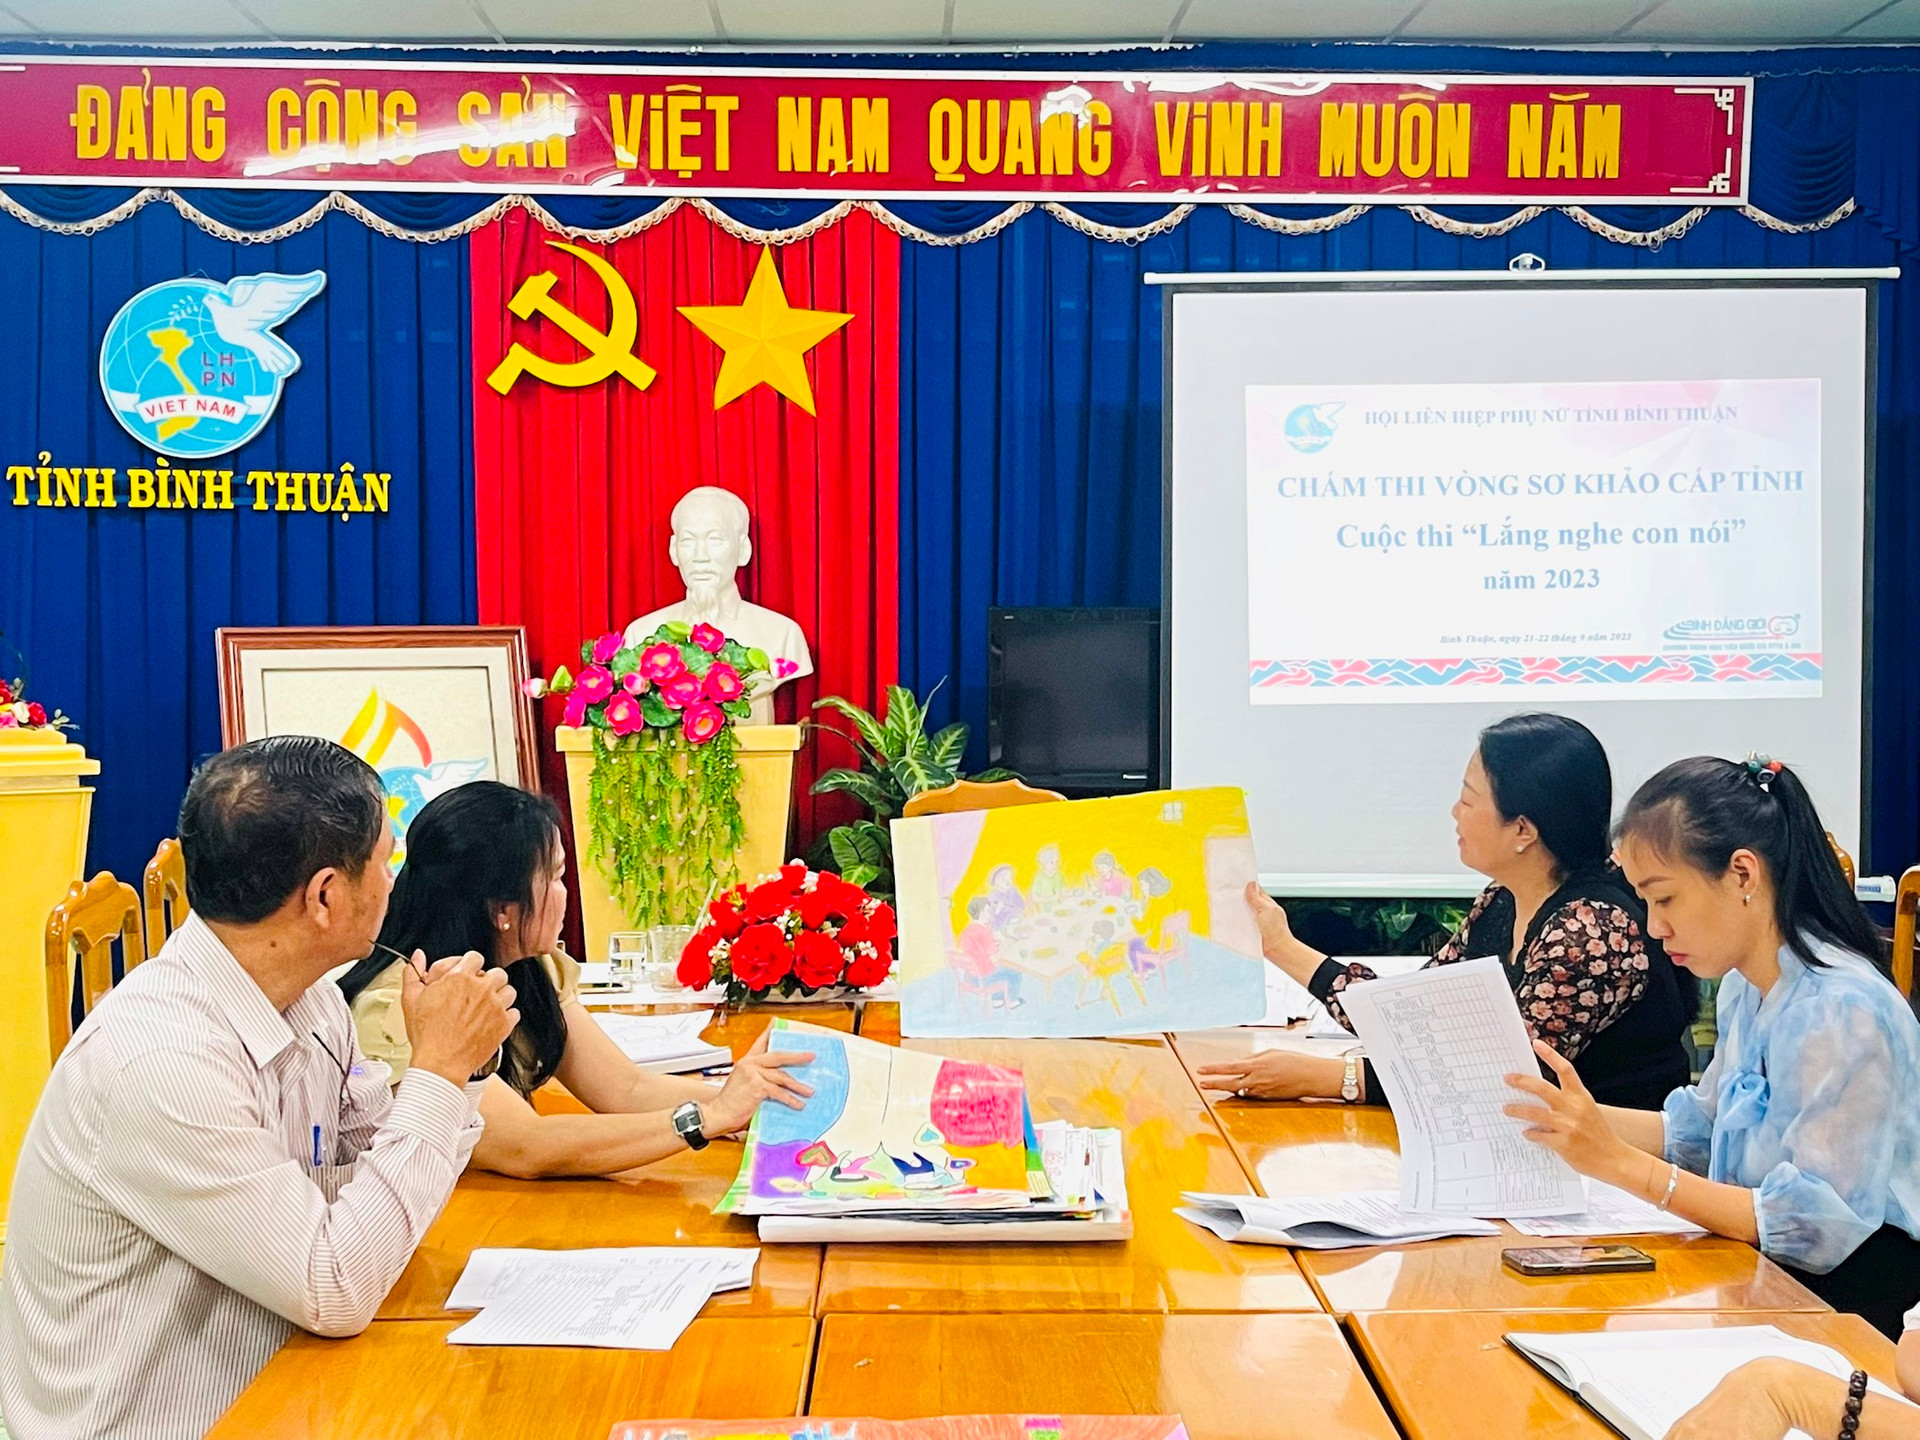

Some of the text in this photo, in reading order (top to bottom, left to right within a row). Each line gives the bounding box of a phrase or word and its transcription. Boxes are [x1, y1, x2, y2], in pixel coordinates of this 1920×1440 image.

[69, 68, 227, 162] ĐẢNG
[266, 78, 418, 173] CỘNG
[778, 96, 890, 174] NAM
[928, 97, 1112, 181] QUANG
[1318, 93, 1472, 179] MUÔN
[1507, 93, 1622, 179] NĂM
[145, 399, 236, 418] VIET NAM
[1365, 410, 1398, 428] HỘI
[1405, 407, 1446, 425] LIÊN
[6, 451, 392, 522] TỈNH BÌNH THUẬN
[1375, 476, 1425, 497] THI
[1434, 469, 1519, 497] VÒNG
[1528, 473, 1566, 495] SƠ
[1574, 467, 1660, 494] KHẢO
[1731, 465, 1804, 492] TỈNH
[1336, 523, 1407, 554] Cuộc
[1416, 524, 1453, 547] thi
[1558, 521, 1623, 551] nghe
[1632, 527, 1679, 544] con
[1484, 568, 1600, 590] năm 2023
